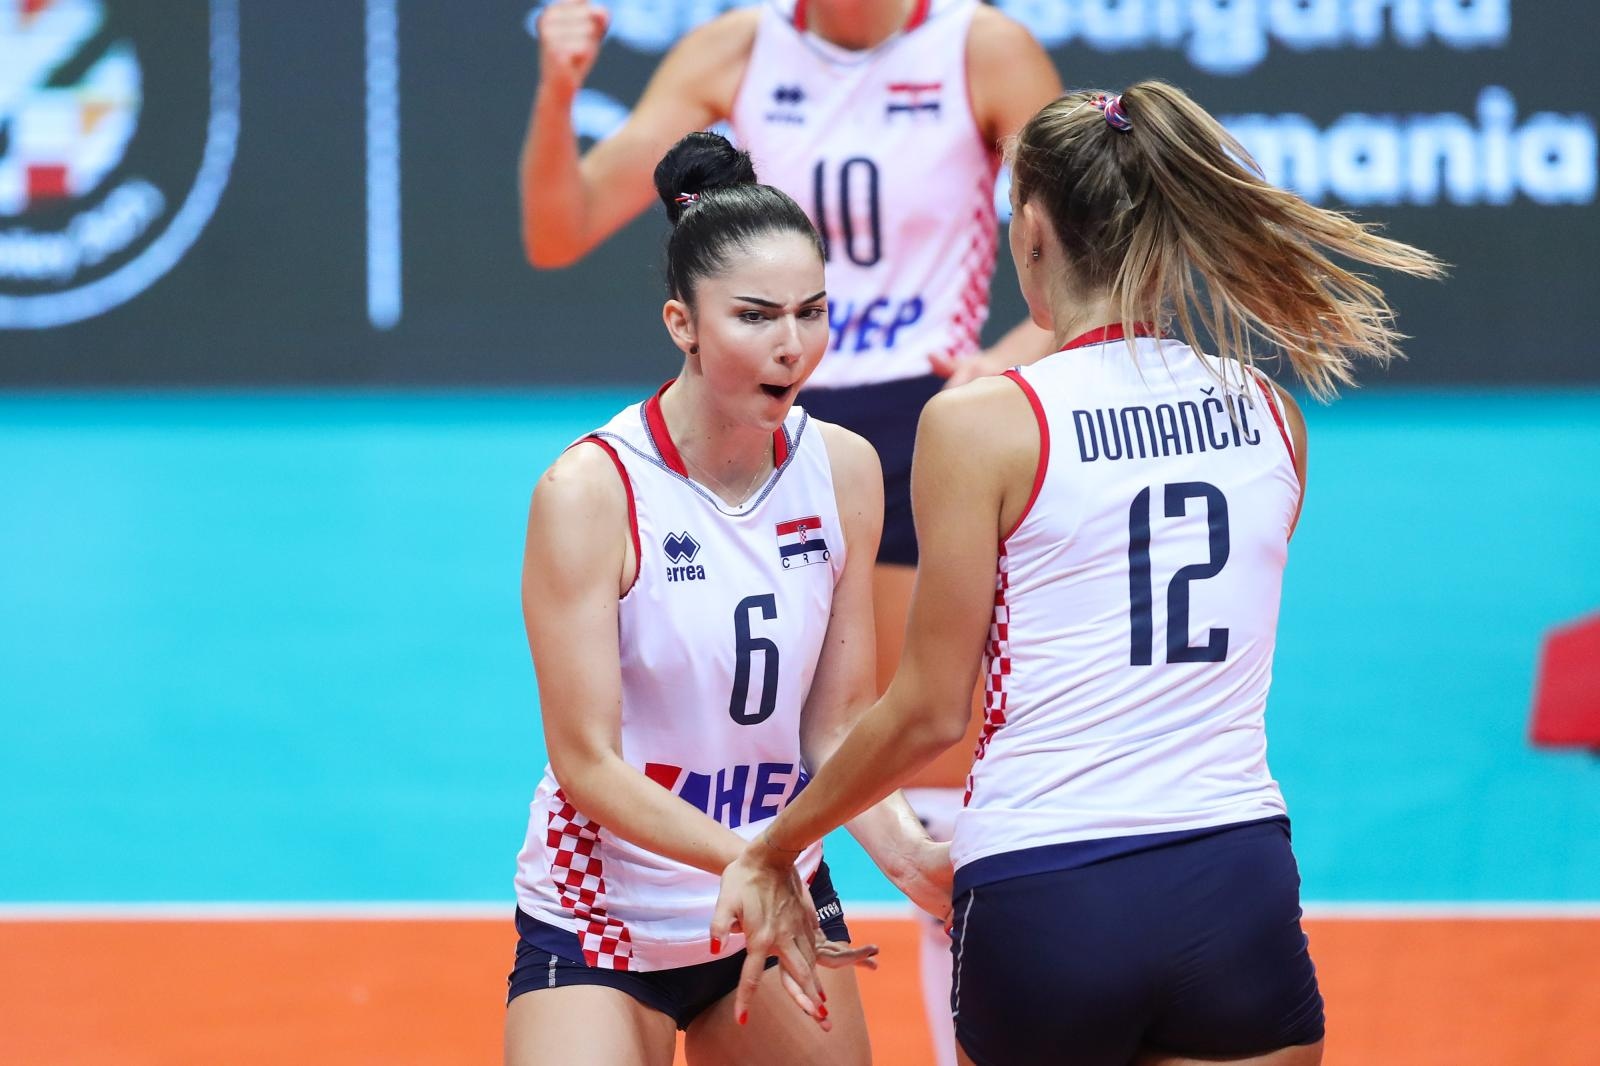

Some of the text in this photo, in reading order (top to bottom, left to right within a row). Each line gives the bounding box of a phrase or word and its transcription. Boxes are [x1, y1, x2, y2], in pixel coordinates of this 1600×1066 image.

[814, 157, 882, 267] 10
[1072, 384, 1261, 463] DUMANČIĆ
[1128, 481, 1230, 666] 12
[729, 593, 779, 726] 6
